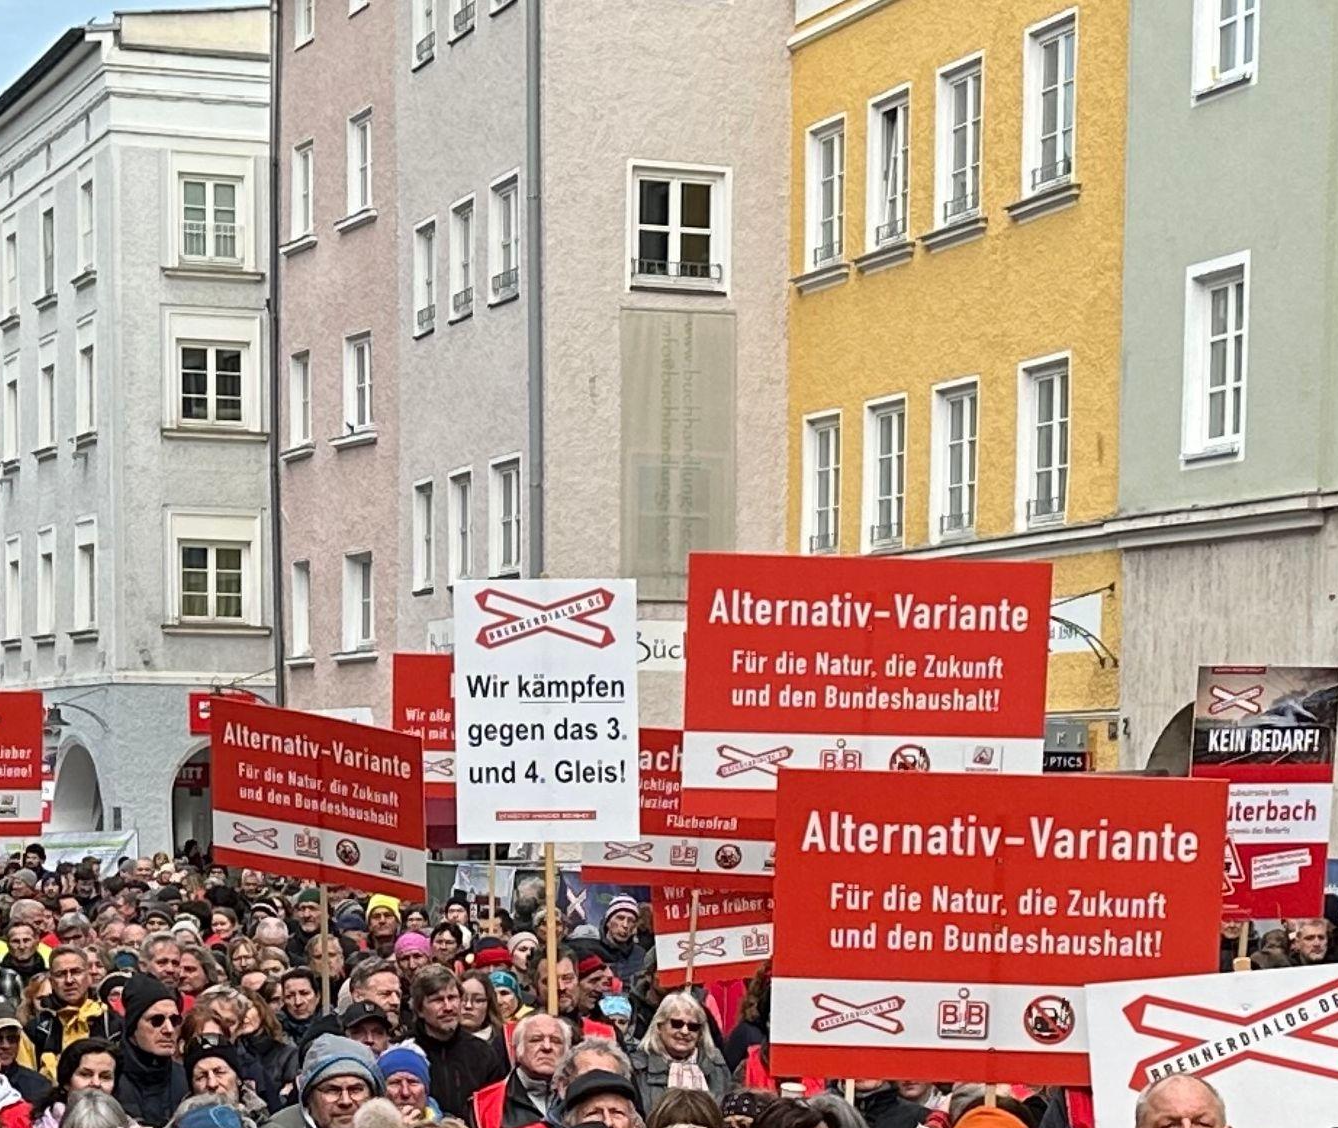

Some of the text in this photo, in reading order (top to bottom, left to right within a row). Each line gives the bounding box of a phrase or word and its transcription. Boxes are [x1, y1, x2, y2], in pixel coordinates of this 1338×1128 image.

[709, 588, 1029, 632] Alternativ-Variante
[732, 649, 1003, 679] Für die Natur, die Zukunft
[467, 674, 625, 707] Wir kämpfen
[732, 685, 1000, 712] und den Bundeshaushalt!
[406, 707, 426, 721] Wir
[468, 717, 628, 747] gegen das 3.
[1208, 728, 1320, 753] KEIN BEDARF!
[223, 722, 411, 780] Alternativ-Variante
[239, 762, 259, 779] Für
[264, 766, 283, 783] die
[330, 779, 348, 796] die
[352, 782, 399, 808] Zukunft
[469, 760, 625, 784] und 4. Gleis!
[239, 786, 263, 802] und
[267, 789, 291, 807] den
[1226, 799, 1317, 823] uterbach
[802, 810, 1198, 864] Alternativ-Variante
[684, 901, 719, 917] Jhre
[831, 883, 1166, 919] Für die Natur, die Zukunft
[831, 924, 1162, 958] und den Bundeshaushalt!
